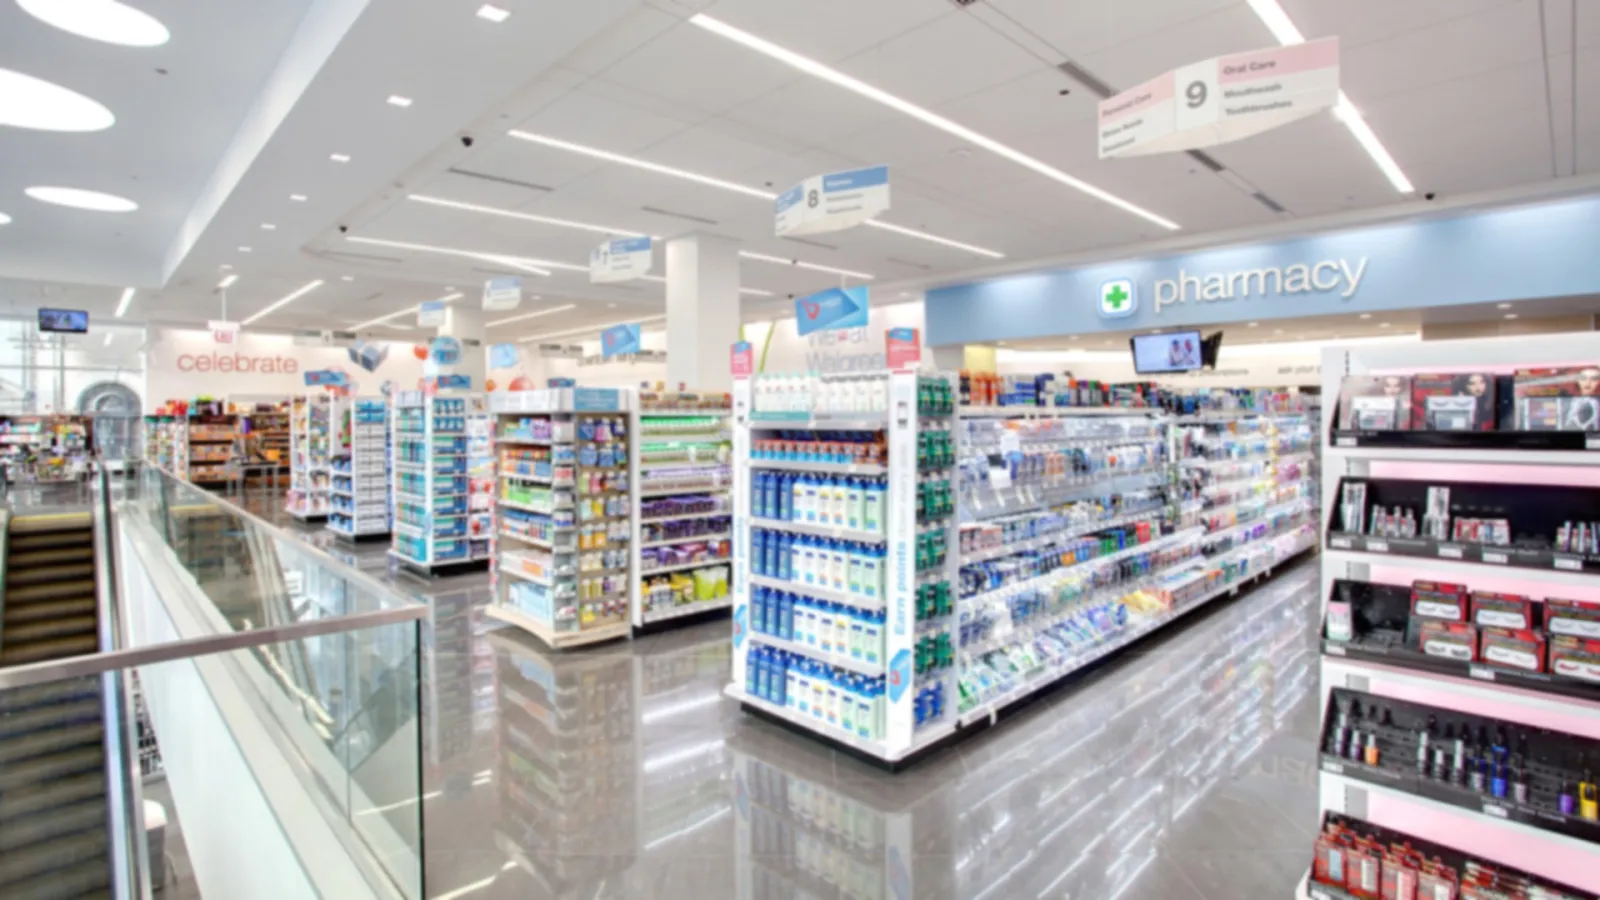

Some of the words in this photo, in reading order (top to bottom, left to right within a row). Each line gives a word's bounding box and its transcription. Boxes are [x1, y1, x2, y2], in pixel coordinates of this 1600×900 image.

[1223, 65, 1247, 75] Oral
[1250, 60, 1276, 71] Care
[1185, 80, 1208, 109] 9
[808, 189, 820, 208] 8
[1153, 256, 1368, 314] pharmacy
[177, 351, 299, 374] celebrate
